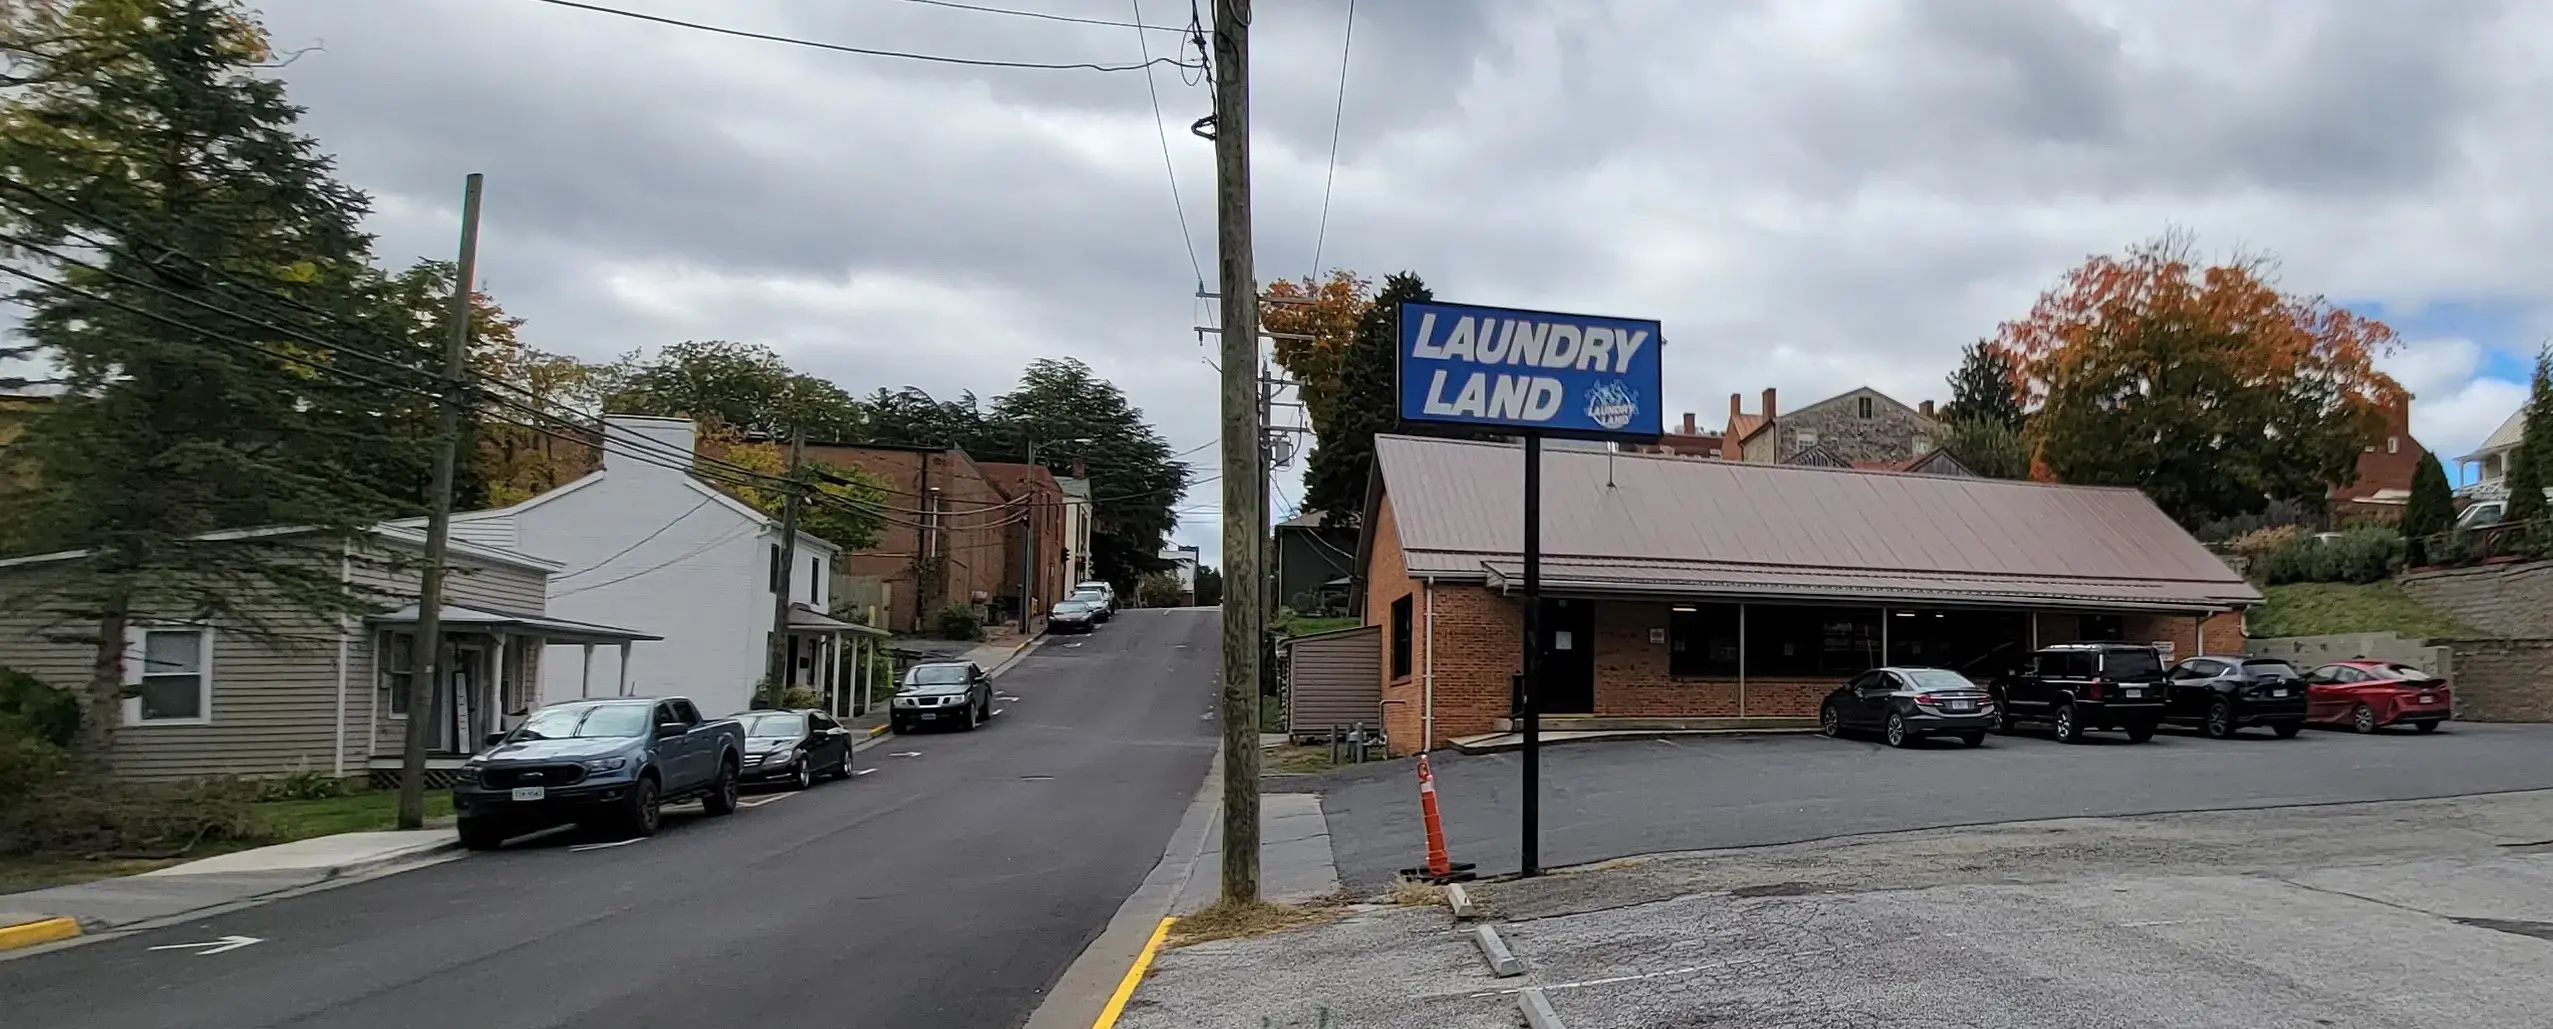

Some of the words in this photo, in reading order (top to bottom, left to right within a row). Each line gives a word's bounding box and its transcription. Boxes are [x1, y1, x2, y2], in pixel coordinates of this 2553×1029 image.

[1412, 313, 1649, 374] LAUNDRY
[1423, 369, 1563, 421] LAND
[1587, 404, 1633, 417] LAUNDRY
[1601, 415, 1630, 425] LAND
